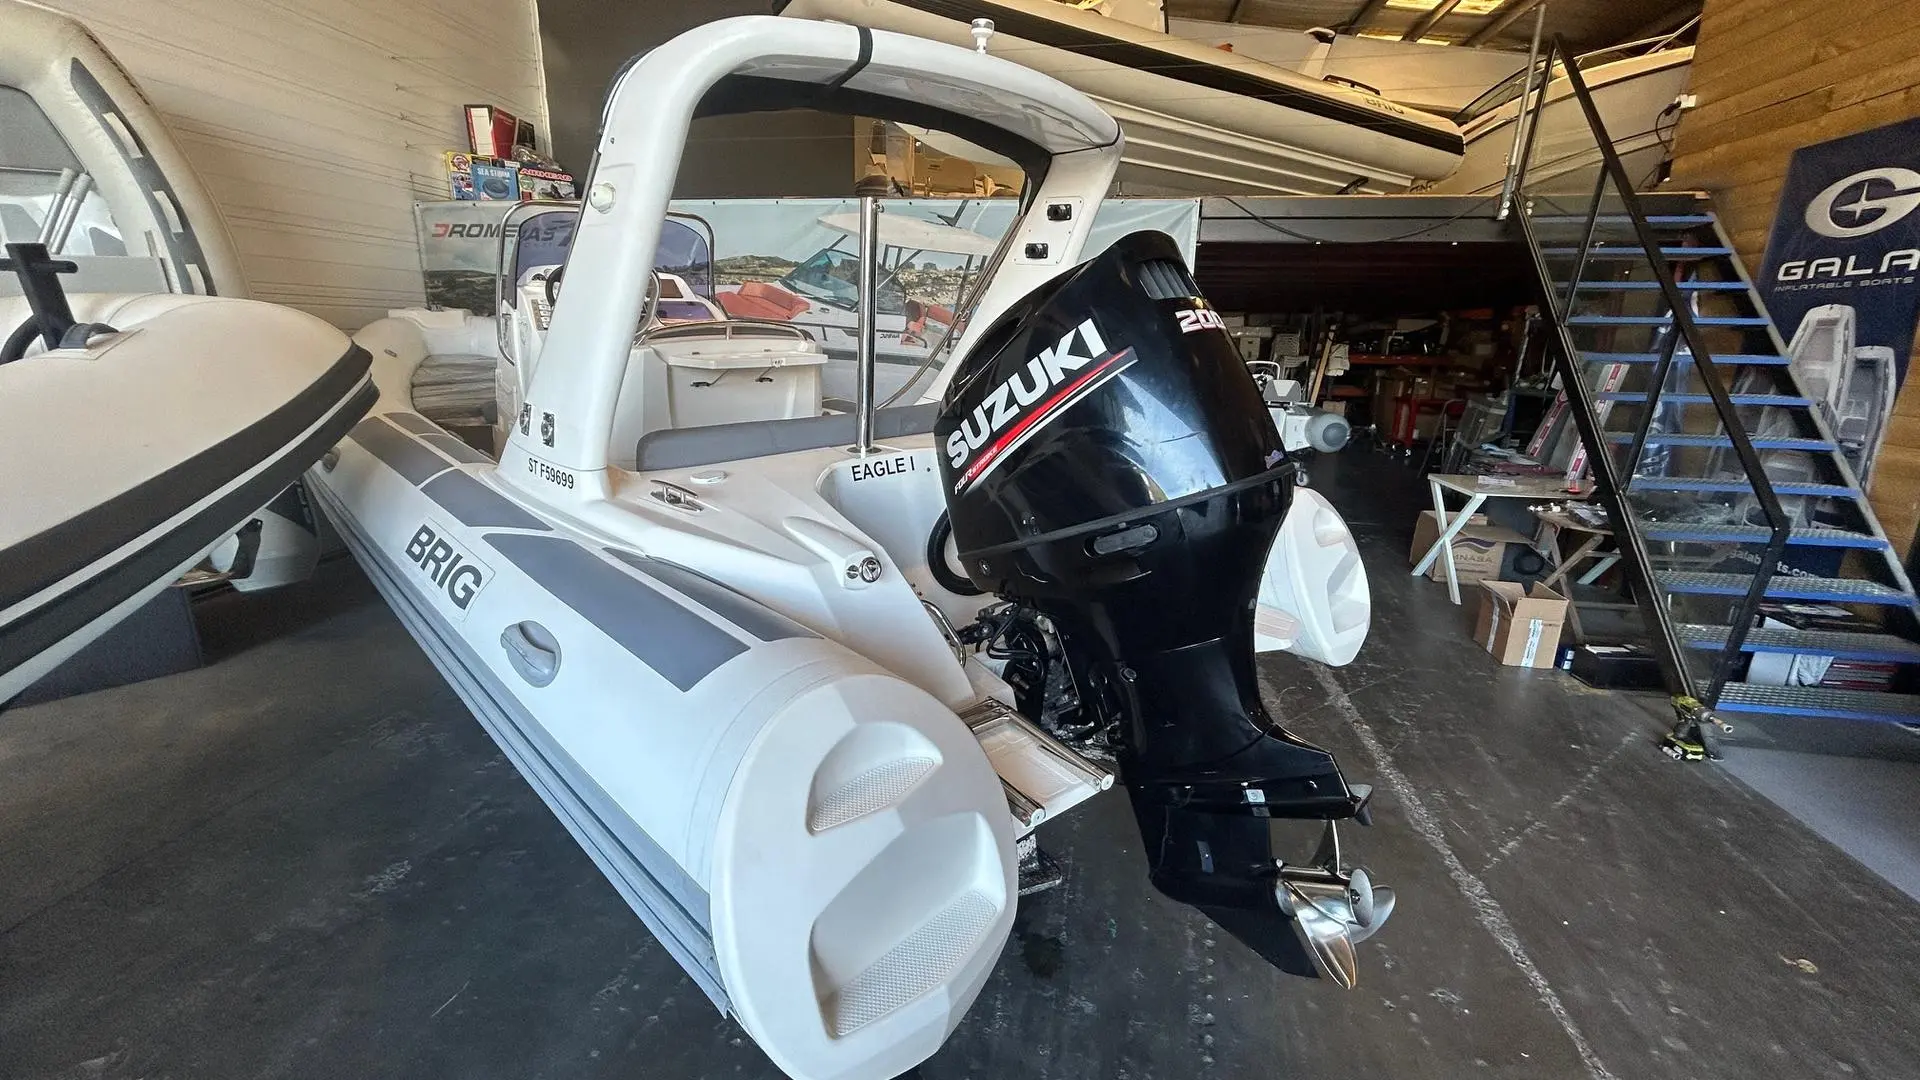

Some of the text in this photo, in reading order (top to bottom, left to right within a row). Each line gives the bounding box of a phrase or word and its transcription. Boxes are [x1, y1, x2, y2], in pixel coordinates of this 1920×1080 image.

[1774, 276, 1915, 292] INFLATABLE BOATS
[1175, 309, 1227, 334] 200
[946, 317, 1108, 469] SUZUKI
[528, 457, 574, 489] ST F59699
[851, 455, 915, 481] EAGLE I
[405, 524, 482, 610] BRIG
